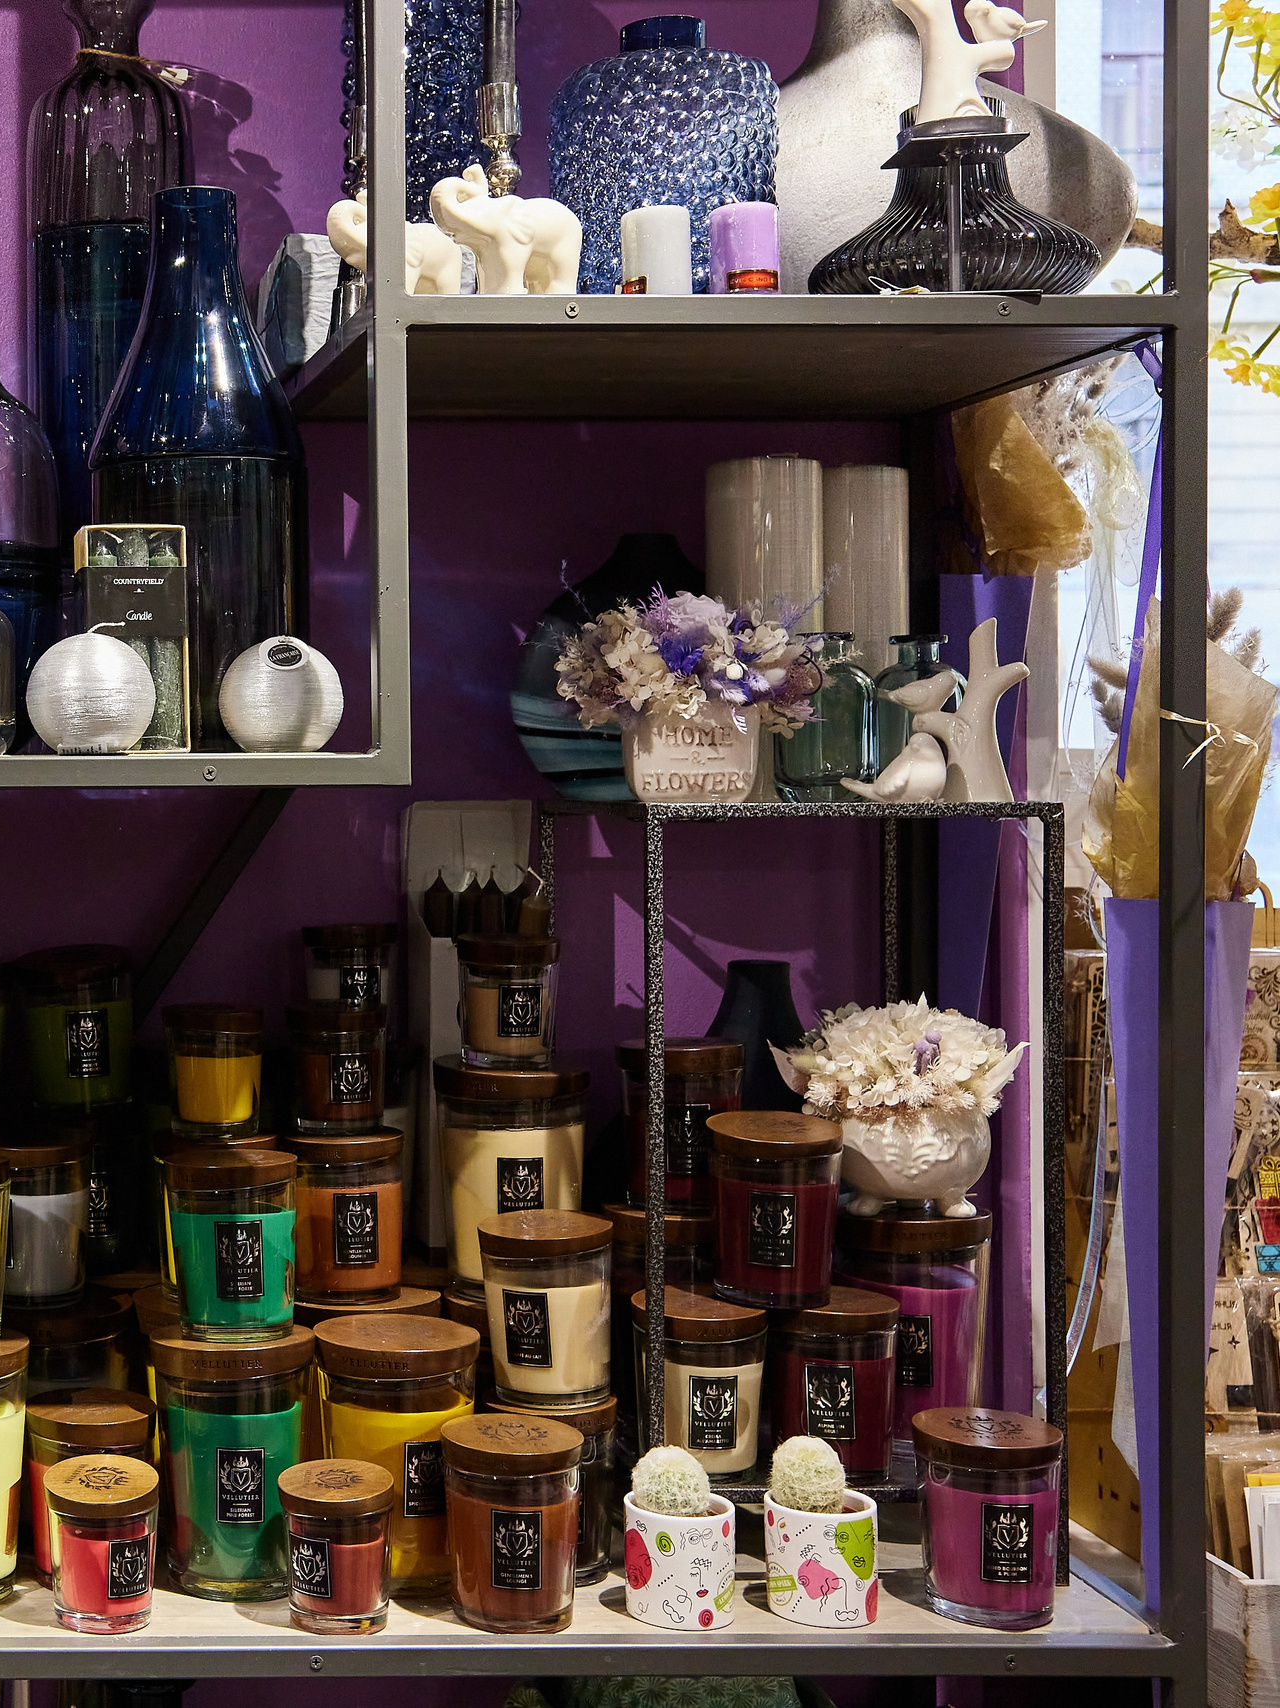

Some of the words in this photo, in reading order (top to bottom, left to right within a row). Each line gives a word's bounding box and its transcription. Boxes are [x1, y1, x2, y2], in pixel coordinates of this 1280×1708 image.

[125, 610, 153, 621] Candle
[665, 725, 734, 747] HOME
[691, 749, 706, 766] &
[641, 770, 752, 794] FLOWERS
[752, 1236, 791, 1245] VELLIER
[191, 1359, 263, 1370] VELLUTIER
[342, 1356, 411, 1371] VELLUTIER
[811, 1409, 851, 1417] VELLUTIER
[694, 1420, 733, 1428] VELLUTIER
[986, 1551, 1028, 1559] VELLUTIER
[497, 1558, 537, 1566] VELLUTIER
[294, 1579, 326, 1593] VELLUTIER
